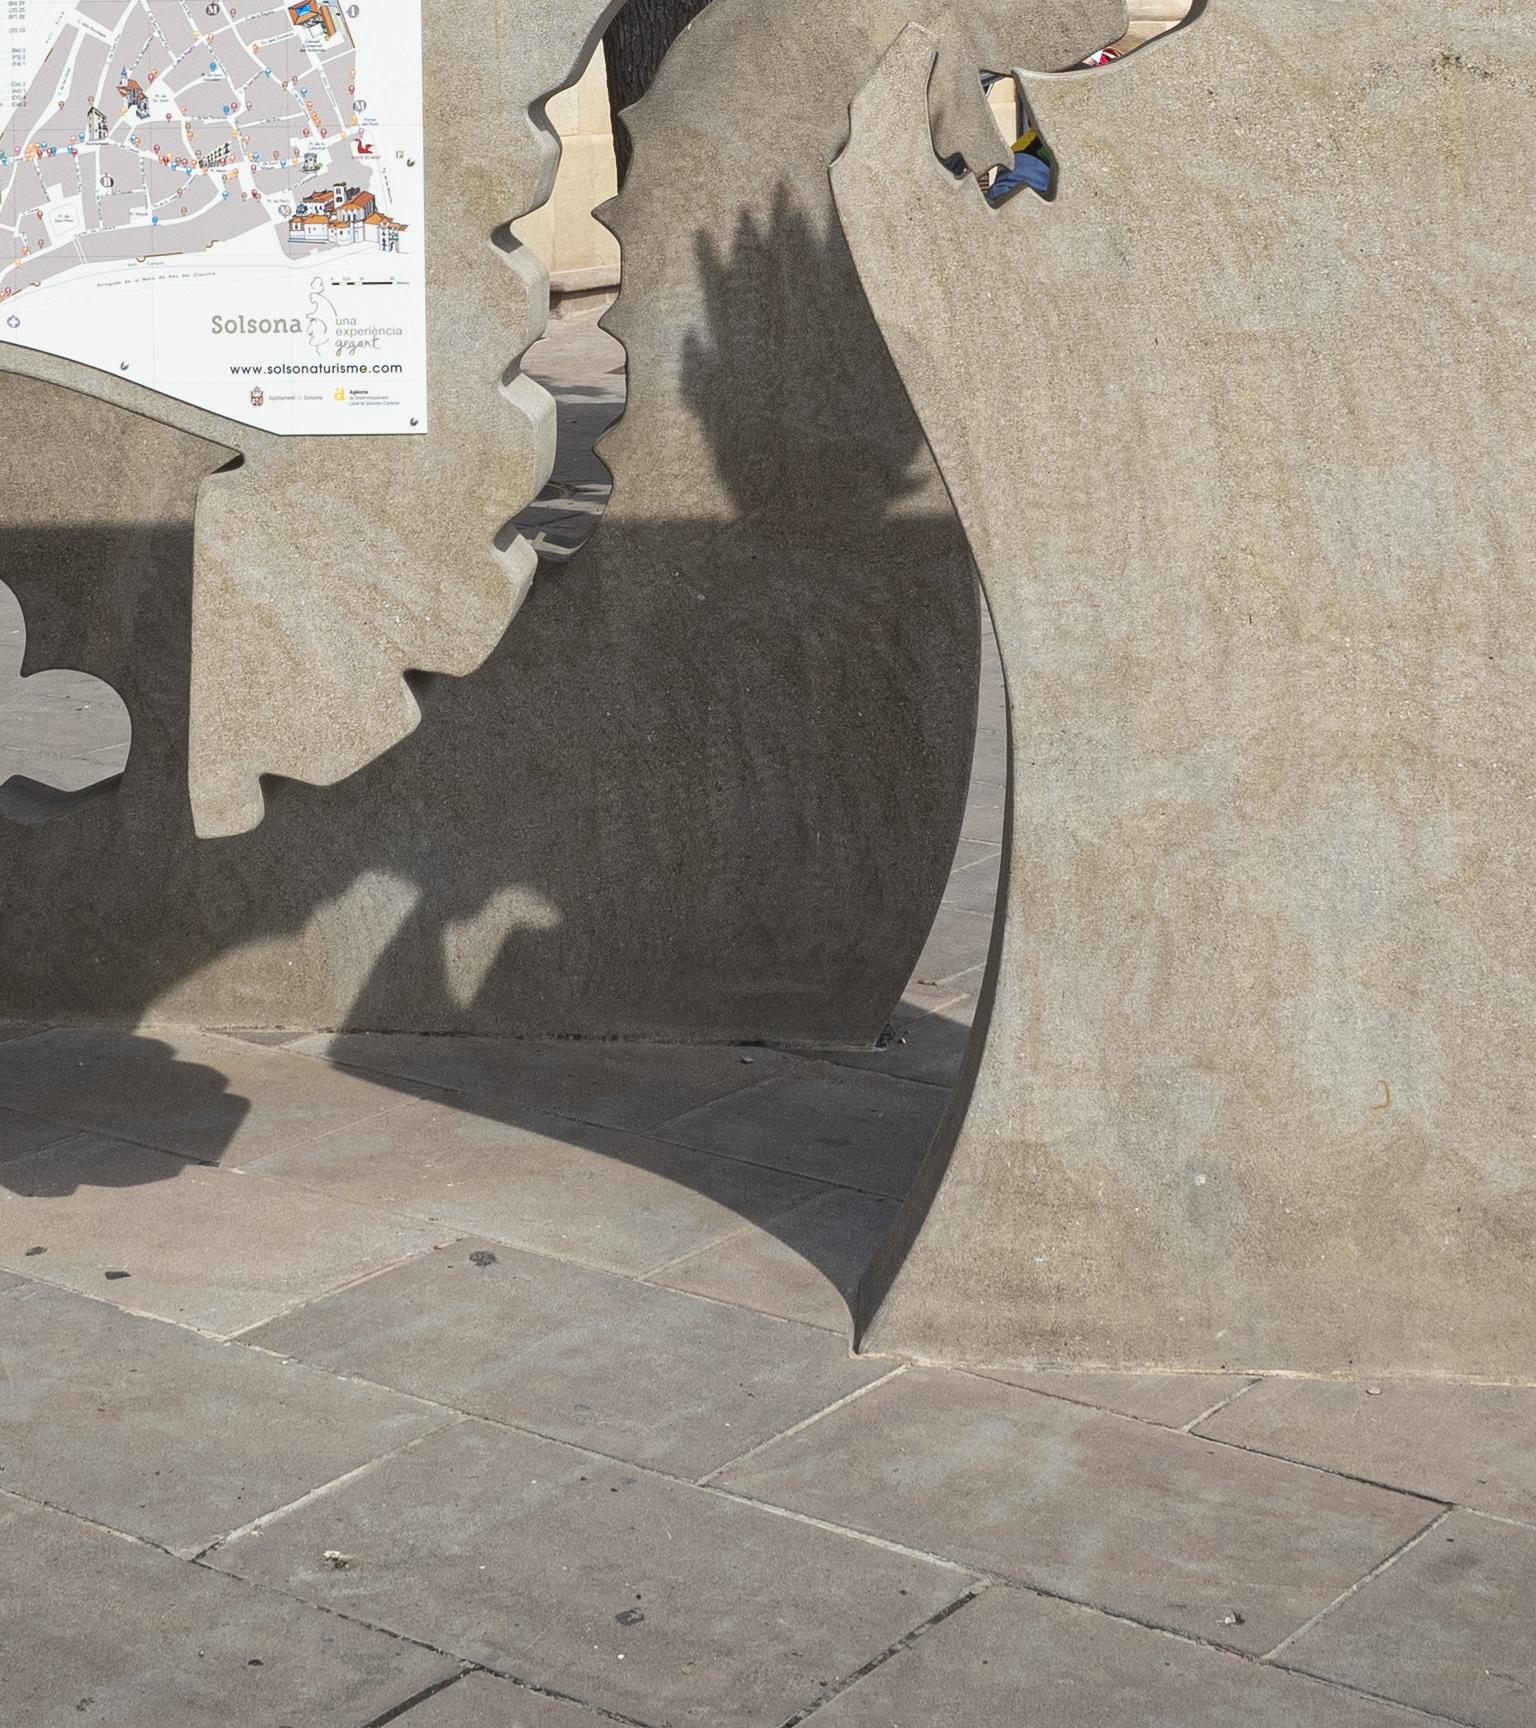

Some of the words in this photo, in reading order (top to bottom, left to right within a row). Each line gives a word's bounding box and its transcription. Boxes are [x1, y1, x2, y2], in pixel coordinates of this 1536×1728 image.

[211, 315, 303, 334] Solsona
[335, 317, 357, 326] una
[335, 326, 403, 338] experiència
[335, 336, 381, 357] gegant
[230, 363, 403, 375] www.solsonaturisme.com
